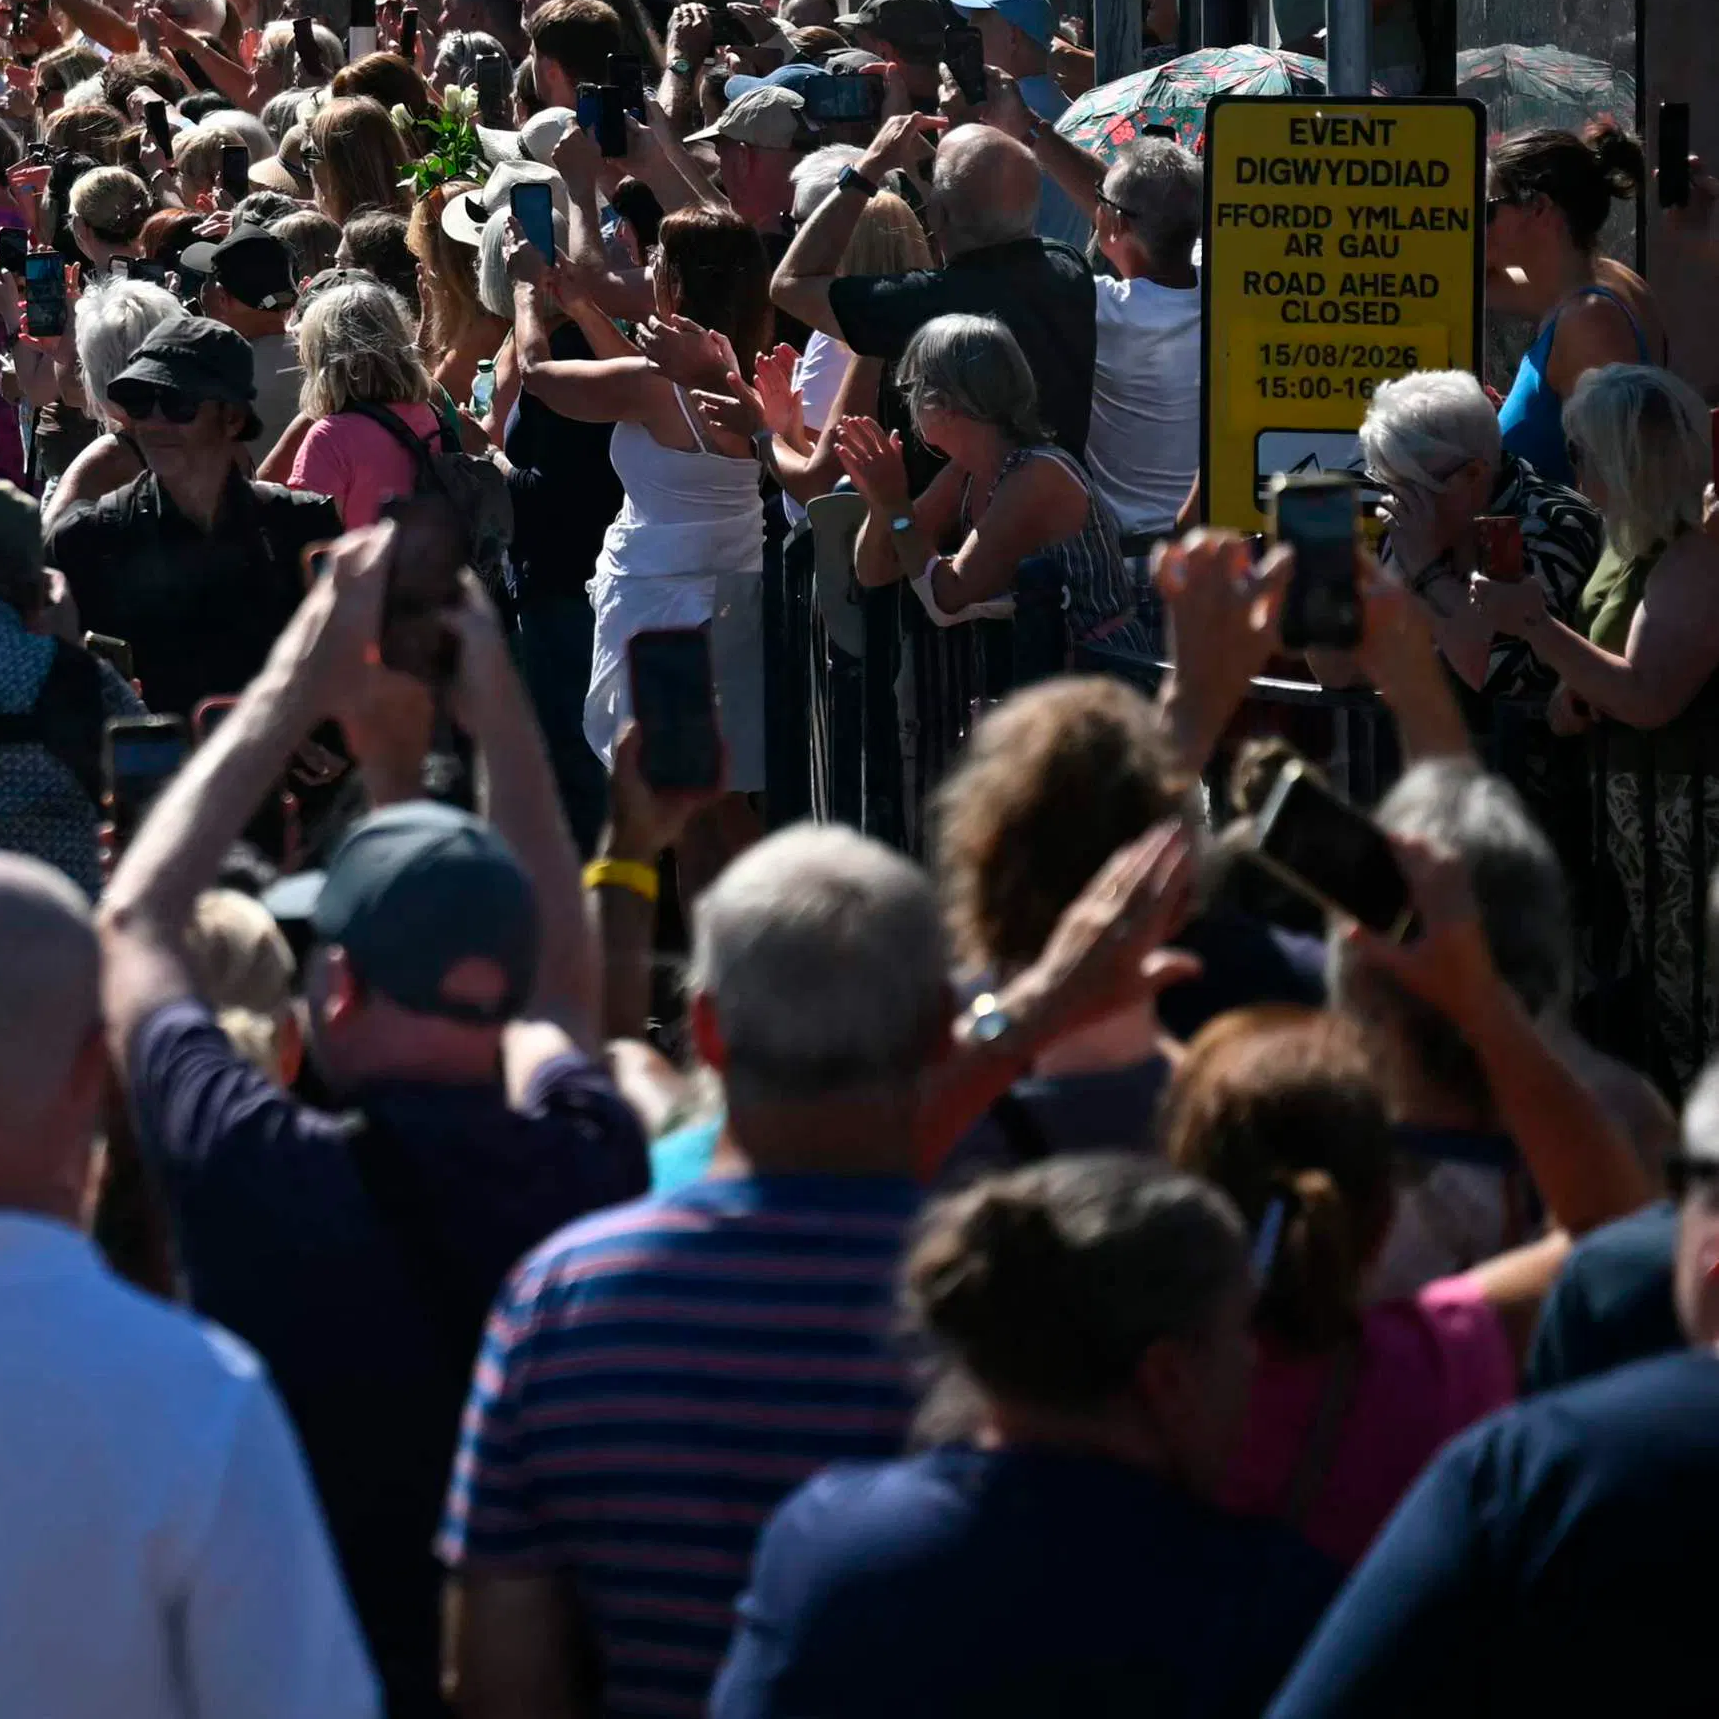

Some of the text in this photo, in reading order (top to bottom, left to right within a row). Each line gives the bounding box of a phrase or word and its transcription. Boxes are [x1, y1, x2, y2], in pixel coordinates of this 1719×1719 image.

[1289, 118, 1397, 147] EVENT
[1236, 156, 1450, 188] DIGWYDDIAD
[1217, 203, 1469, 232] FFORDD YMLAEN
[1284, 234, 1401, 260] AR GAU
[1243, 271, 1440, 298] ROAD AHEAD
[1280, 301, 1401, 325] CLOSED
[1259, 344, 1418, 370] 15/08/2026
[1256, 376, 1375, 400] 15:00-16
